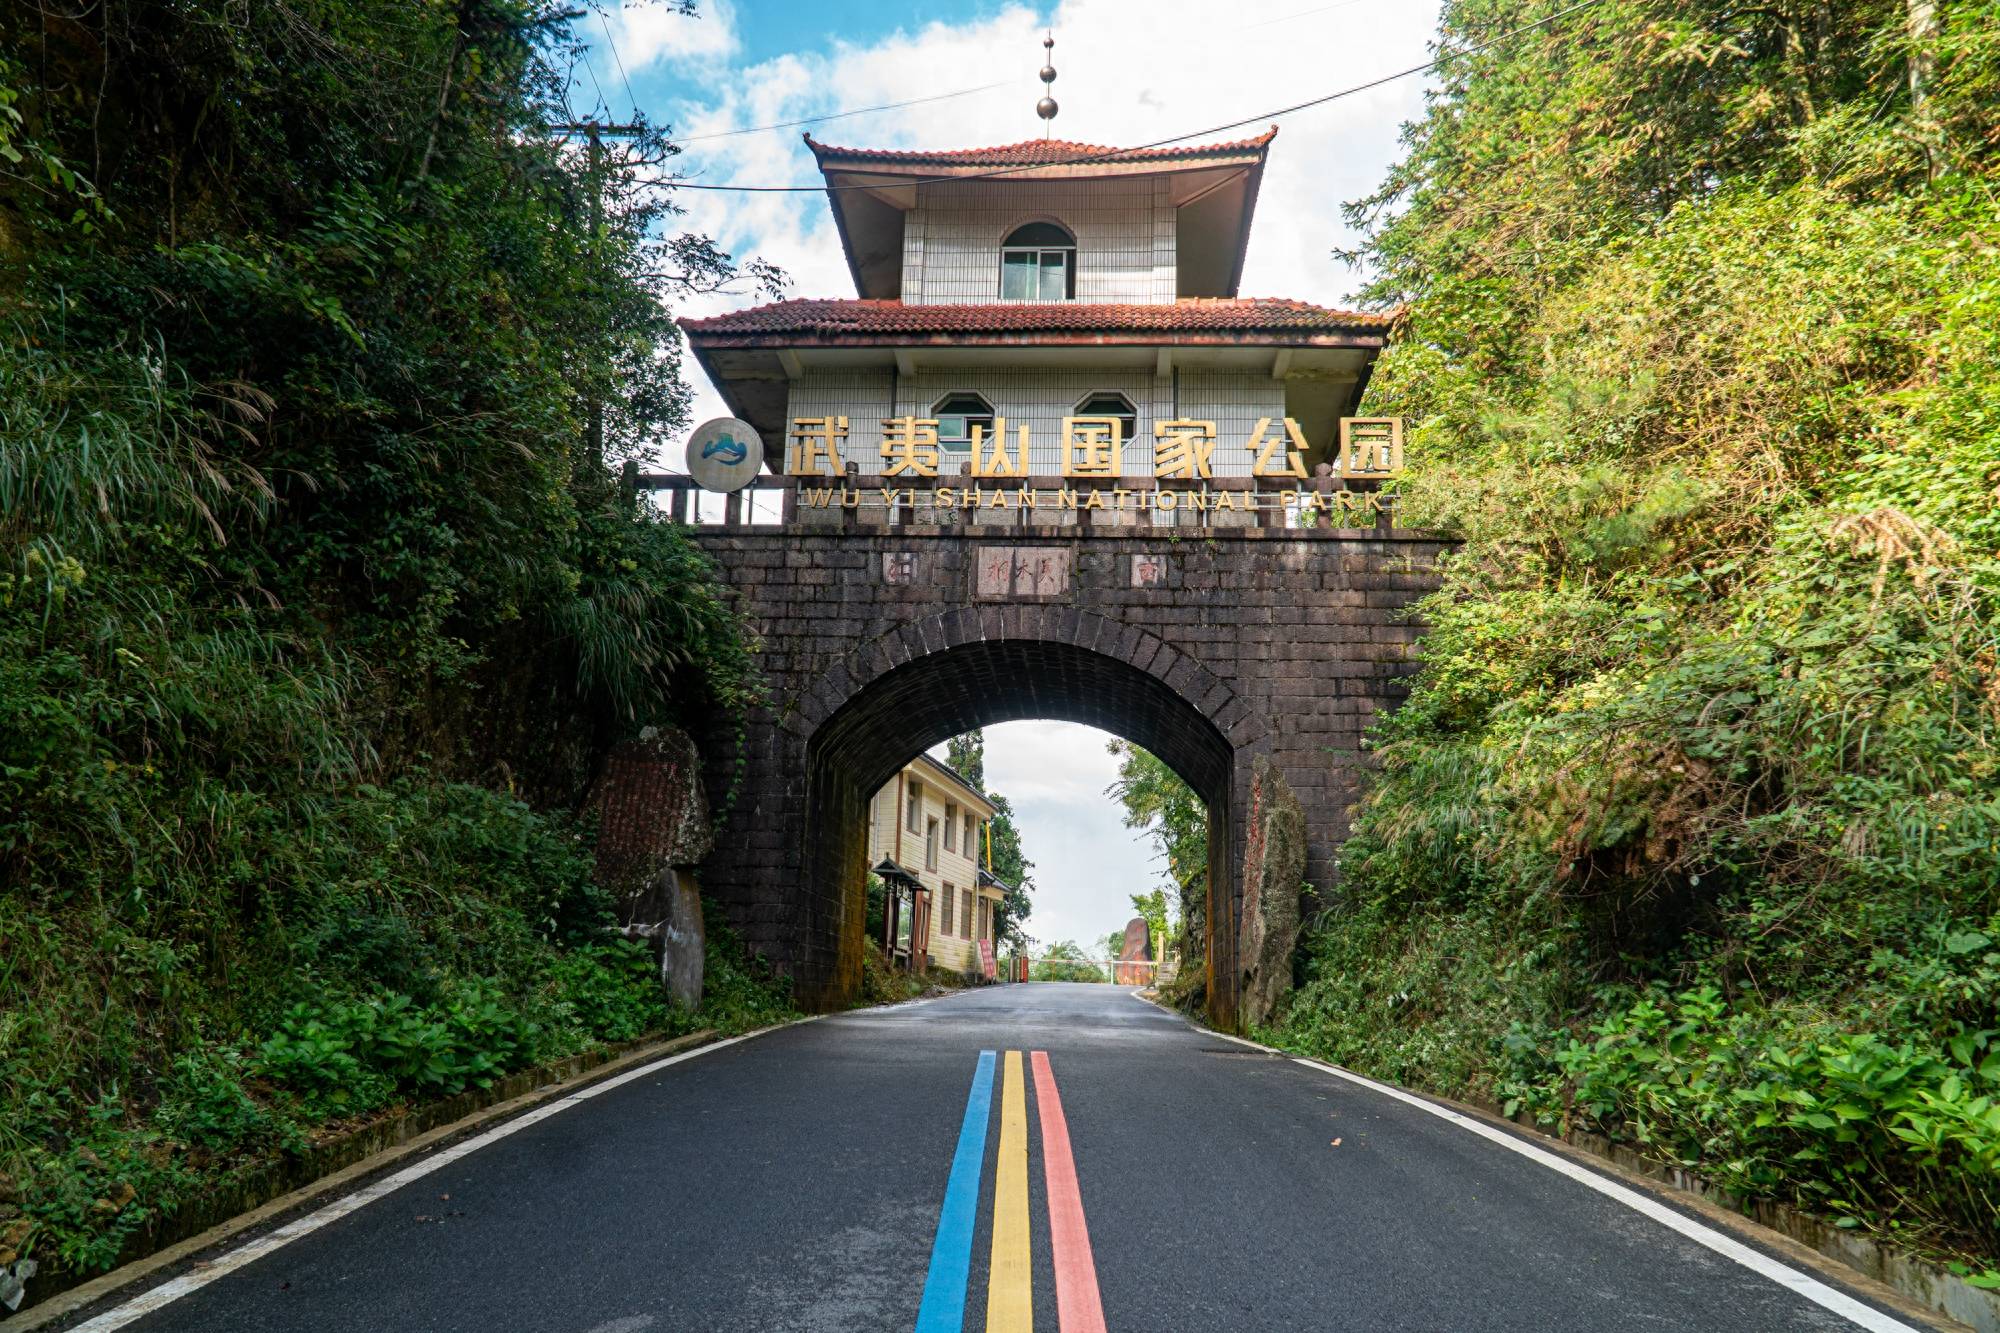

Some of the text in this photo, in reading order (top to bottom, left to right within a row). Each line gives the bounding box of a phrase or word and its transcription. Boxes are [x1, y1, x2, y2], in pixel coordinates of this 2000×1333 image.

[789, 415, 1404, 479] 武夷山国家公园
[806, 487, 1384, 511] WU YI SHAN NATIONAL PARK
